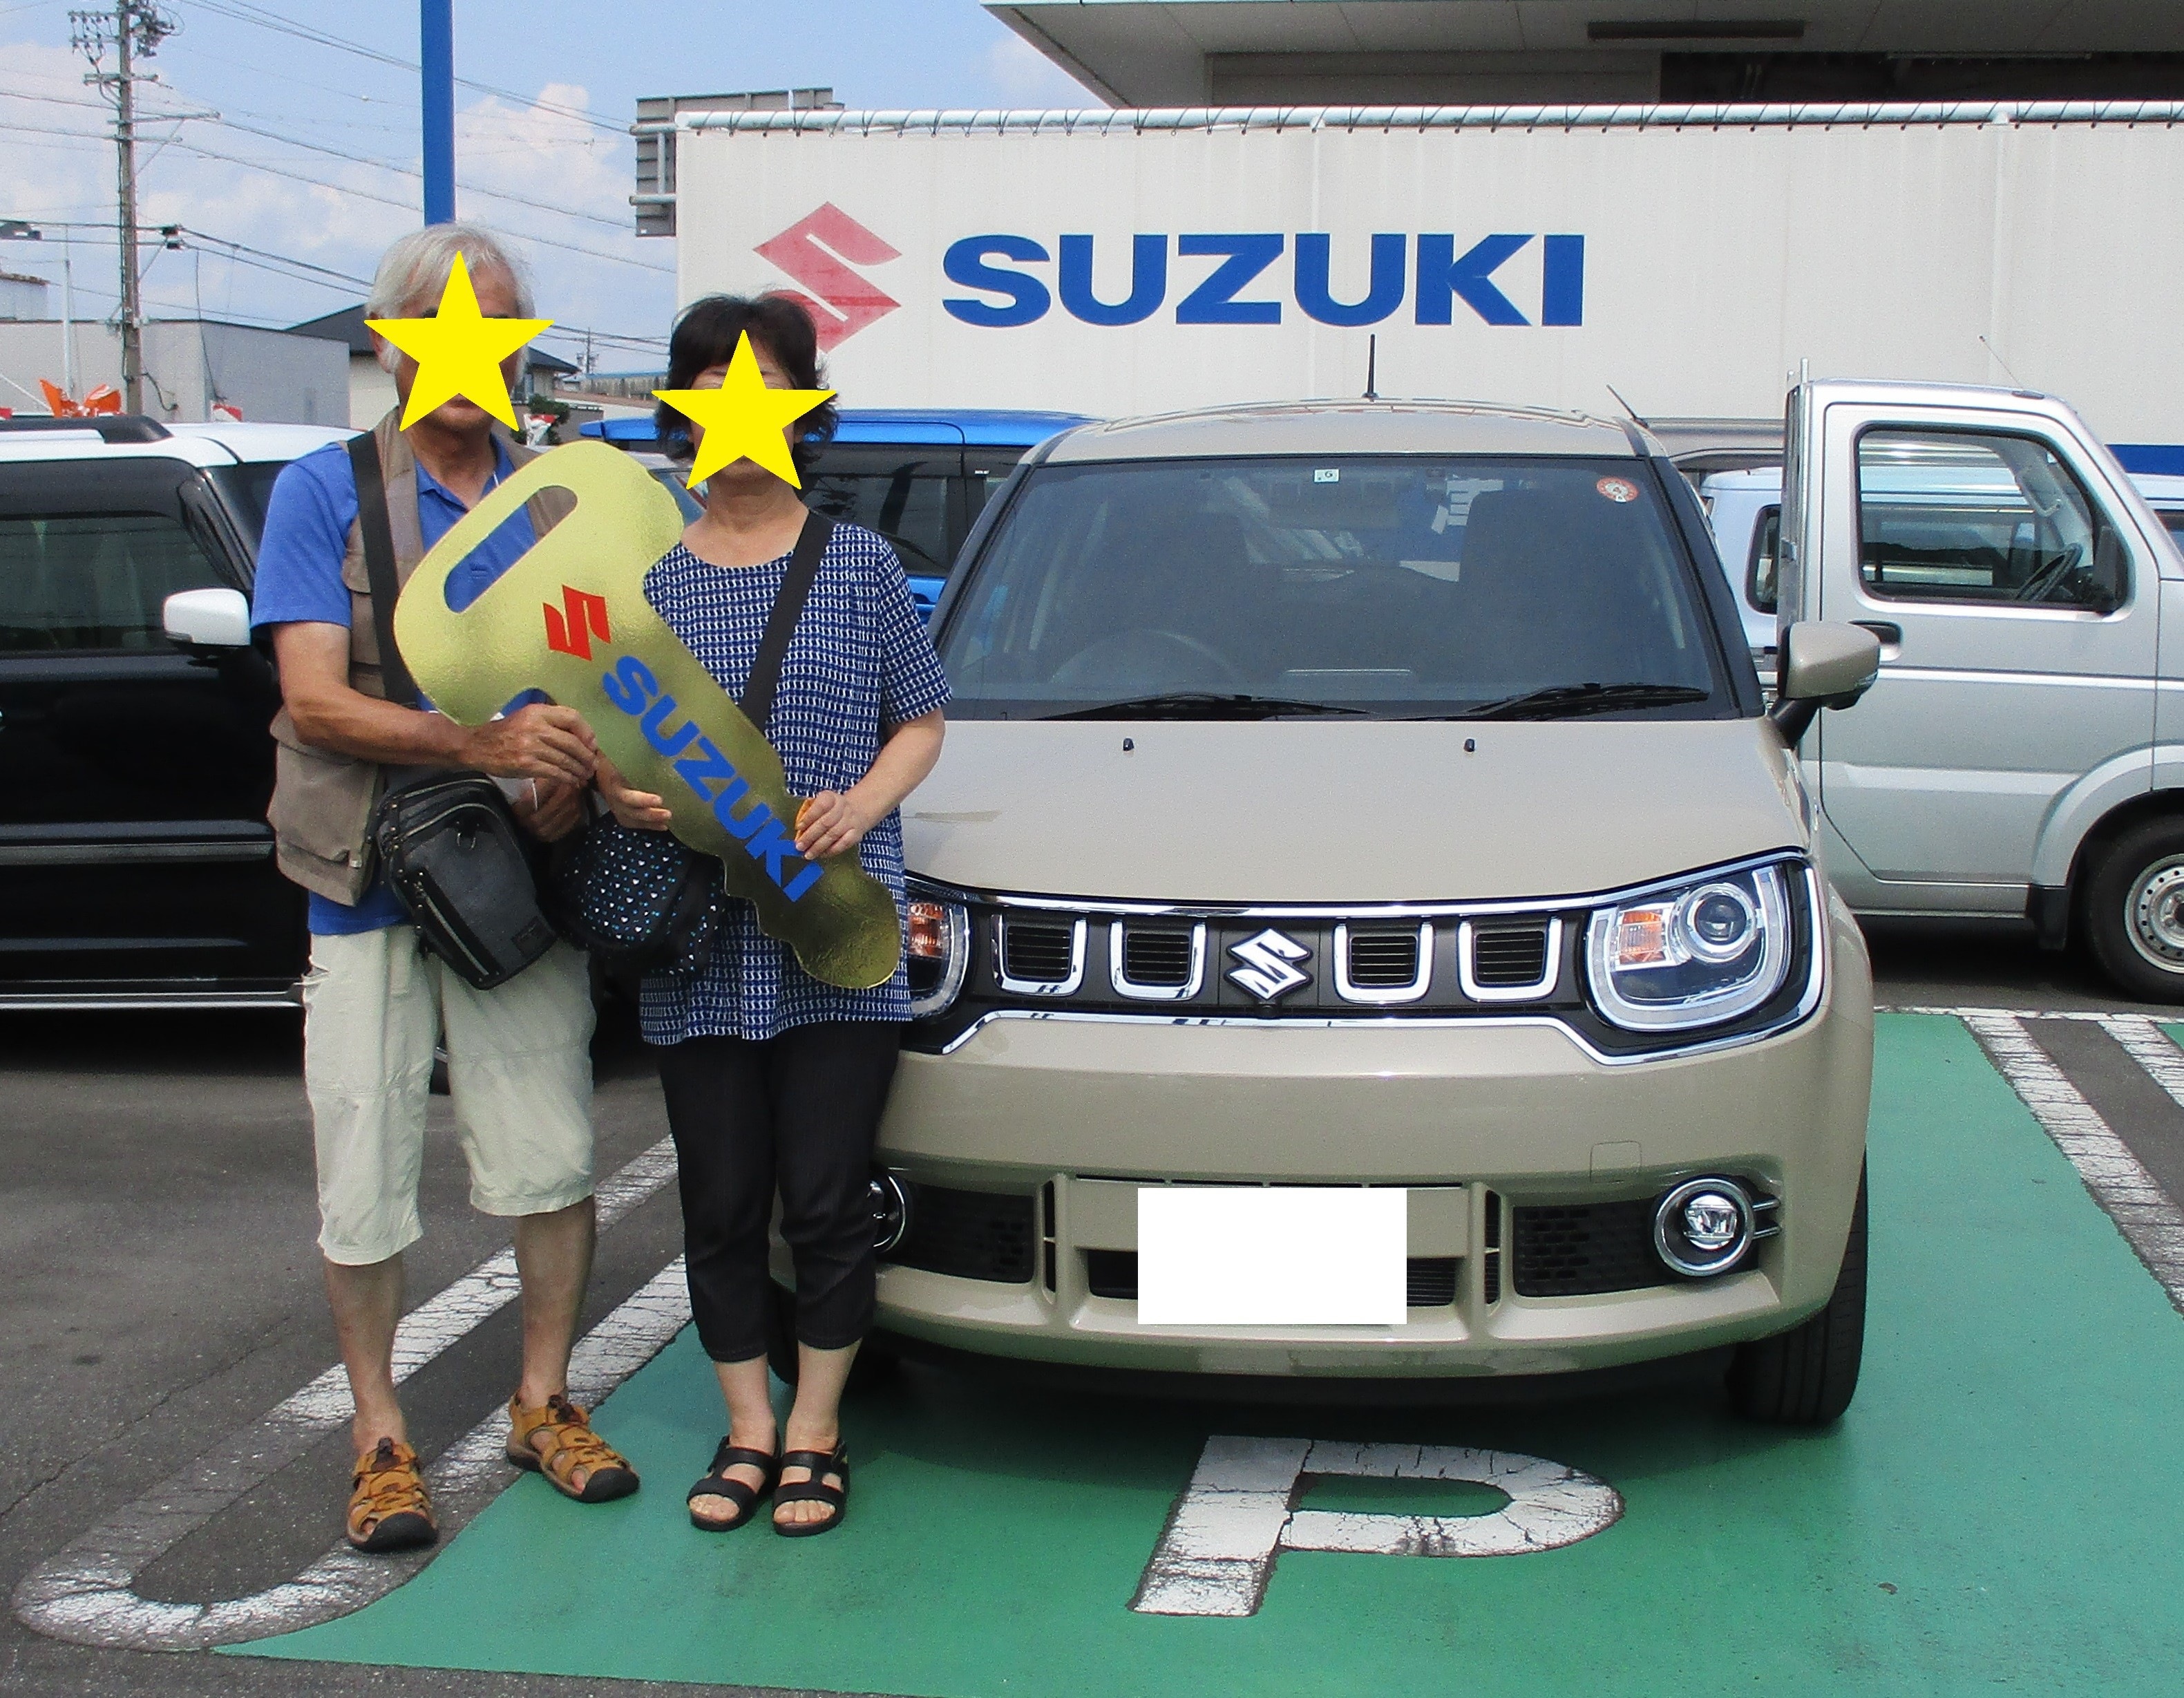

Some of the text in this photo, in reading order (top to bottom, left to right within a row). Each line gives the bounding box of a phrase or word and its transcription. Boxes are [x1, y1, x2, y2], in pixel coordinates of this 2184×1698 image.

[943, 232, 1584, 327] SUZUKI
[602, 656, 824, 902] SUZUKI
[1128, 1435, 1624, 1616] P
